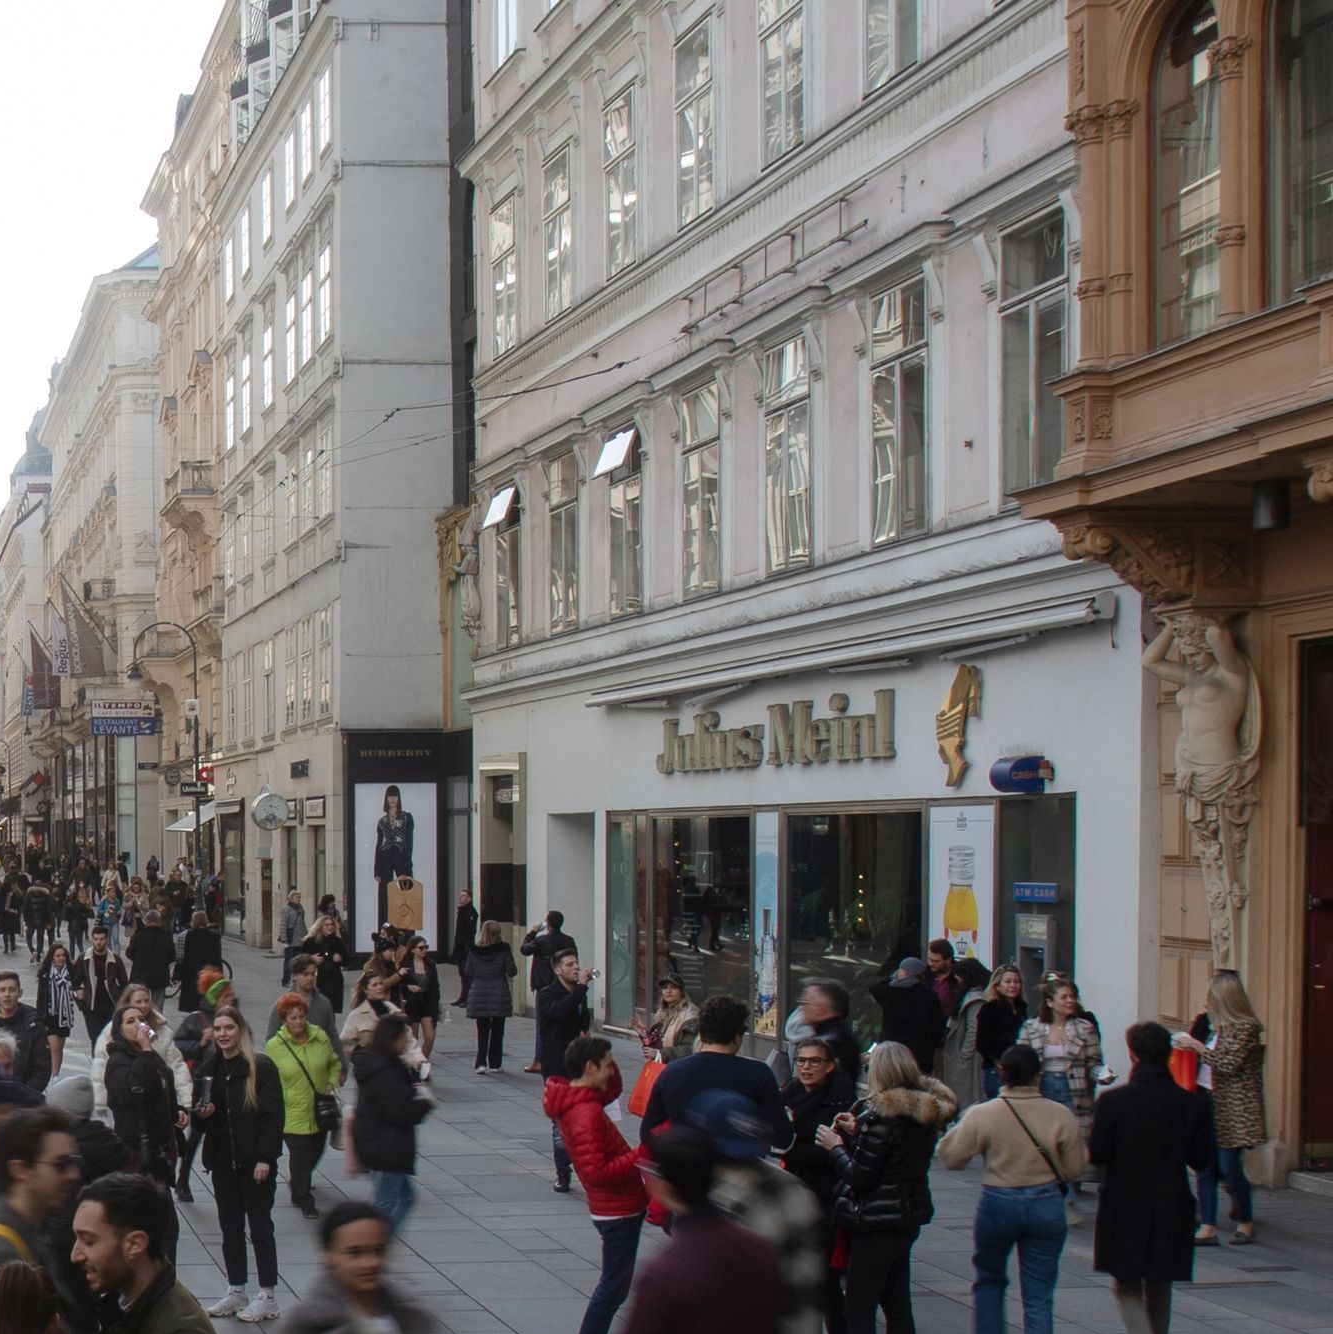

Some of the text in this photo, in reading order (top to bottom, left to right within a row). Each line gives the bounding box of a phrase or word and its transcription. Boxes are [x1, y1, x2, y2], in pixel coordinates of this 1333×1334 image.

[58, 639, 70, 674] Regus
[93, 726, 139, 734] LEVANTE
[656, 688, 896, 774] Julius Meinl
[1015, 888, 1055, 897] ATM CASH
